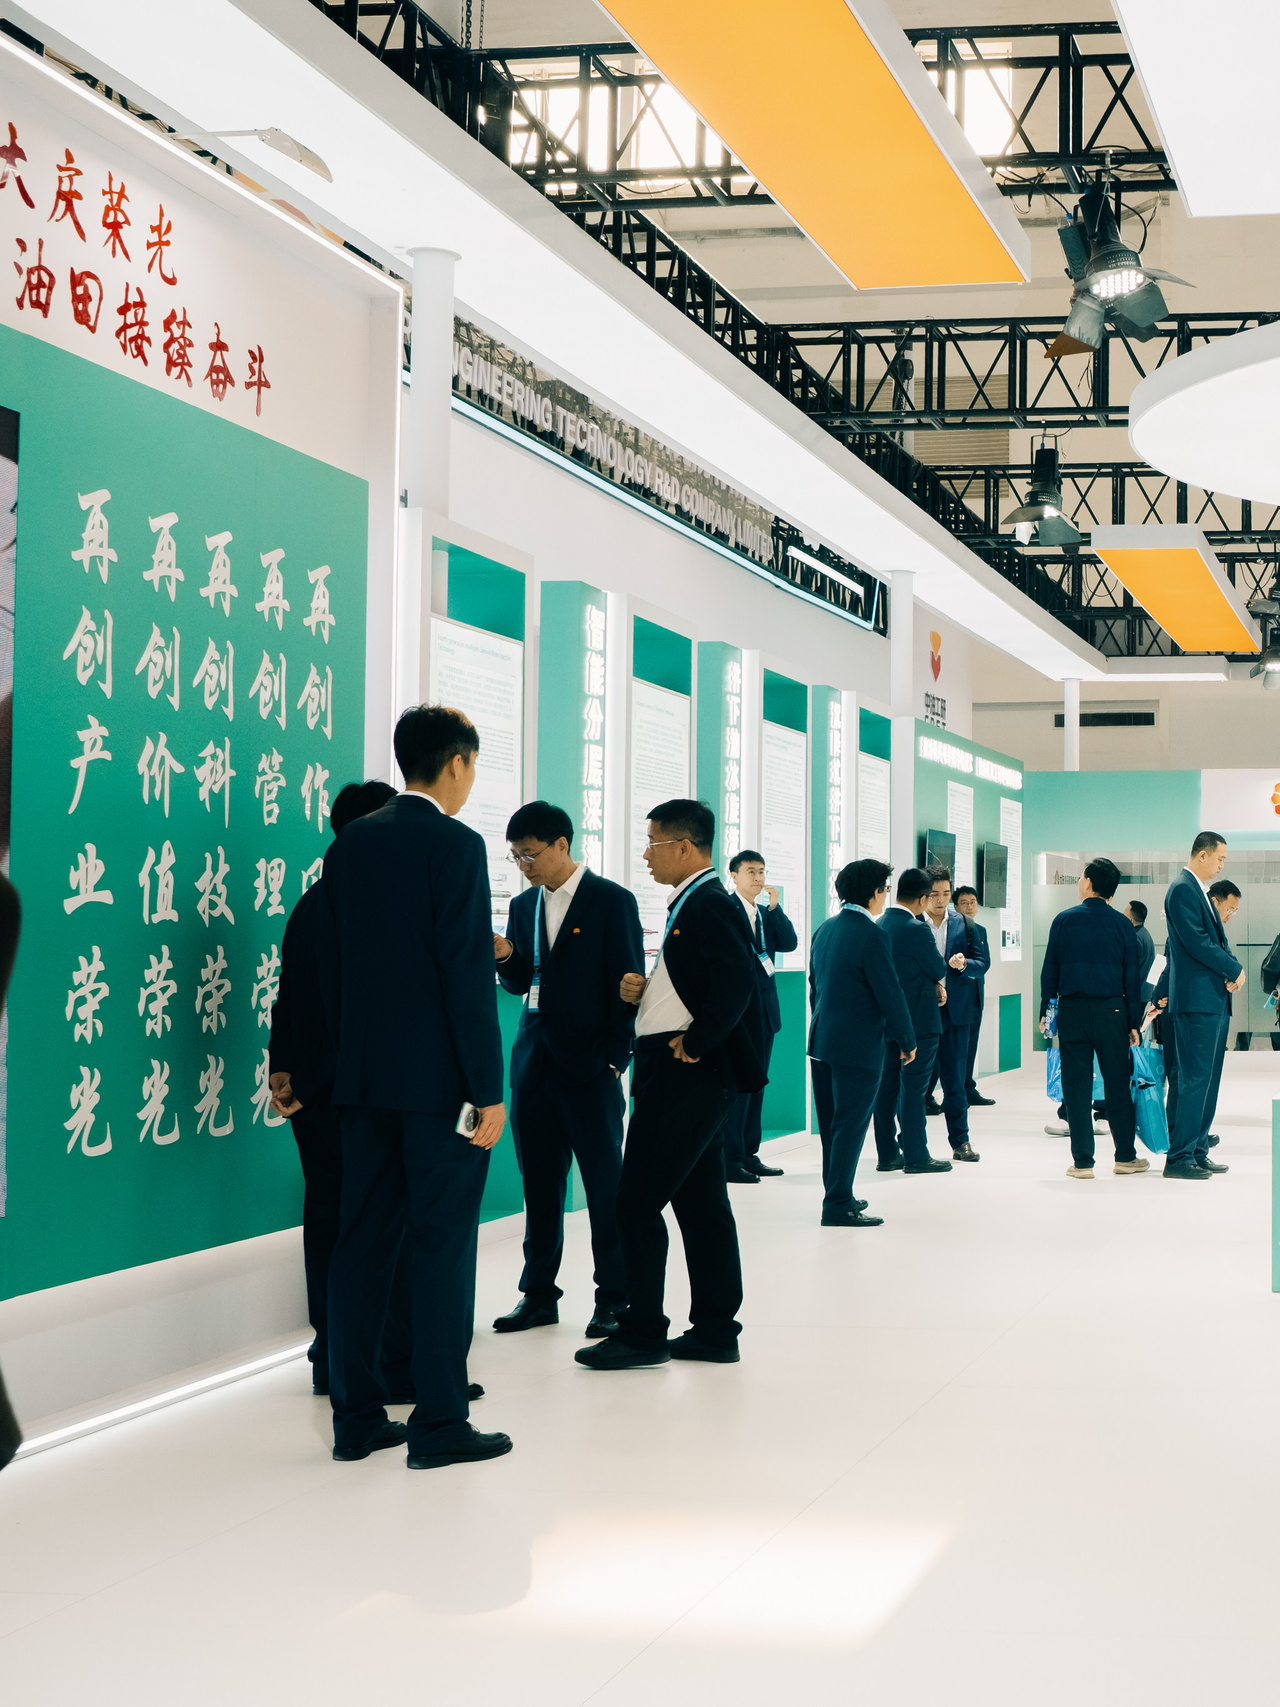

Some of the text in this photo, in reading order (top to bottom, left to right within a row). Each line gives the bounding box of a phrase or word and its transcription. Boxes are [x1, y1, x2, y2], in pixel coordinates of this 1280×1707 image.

[0, 122, 177, 286] 大庆荣光
[452, 341, 775, 561] NGINEERING TECHNOLOGY R&D COMPANY LIMITED
[63, 488, 118, 1157] 再创产业荣光
[135, 512, 185, 1145] 再创价值荣光
[193, 531, 239, 1137] 再创科技荣光
[249, 548, 290, 1127] 再创管理荣光
